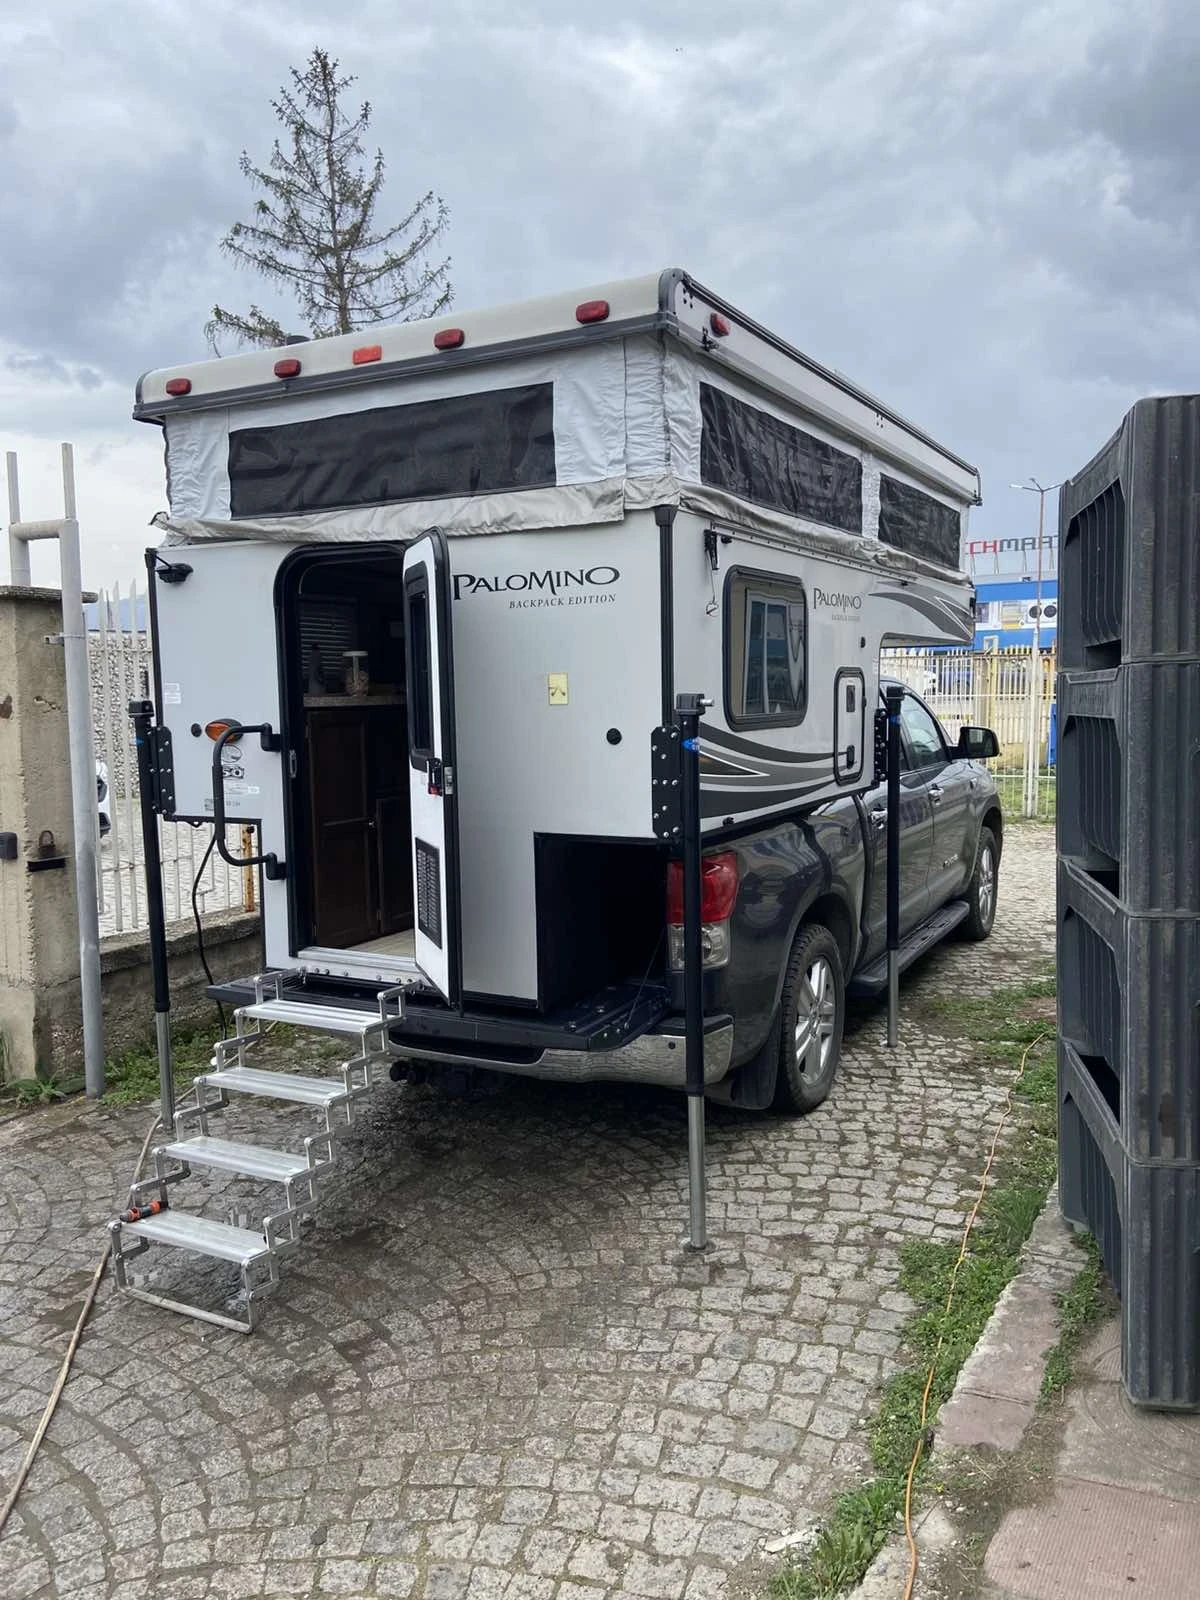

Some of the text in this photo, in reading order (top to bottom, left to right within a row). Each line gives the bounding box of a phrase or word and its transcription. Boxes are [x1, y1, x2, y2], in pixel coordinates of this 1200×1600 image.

[964, 535, 1058, 555] CHMAR
[452, 566, 620, 600] PALOMINO
[509, 594, 617, 609] BACKPACK EDITION
[813, 588, 862, 612] PALOMINO
